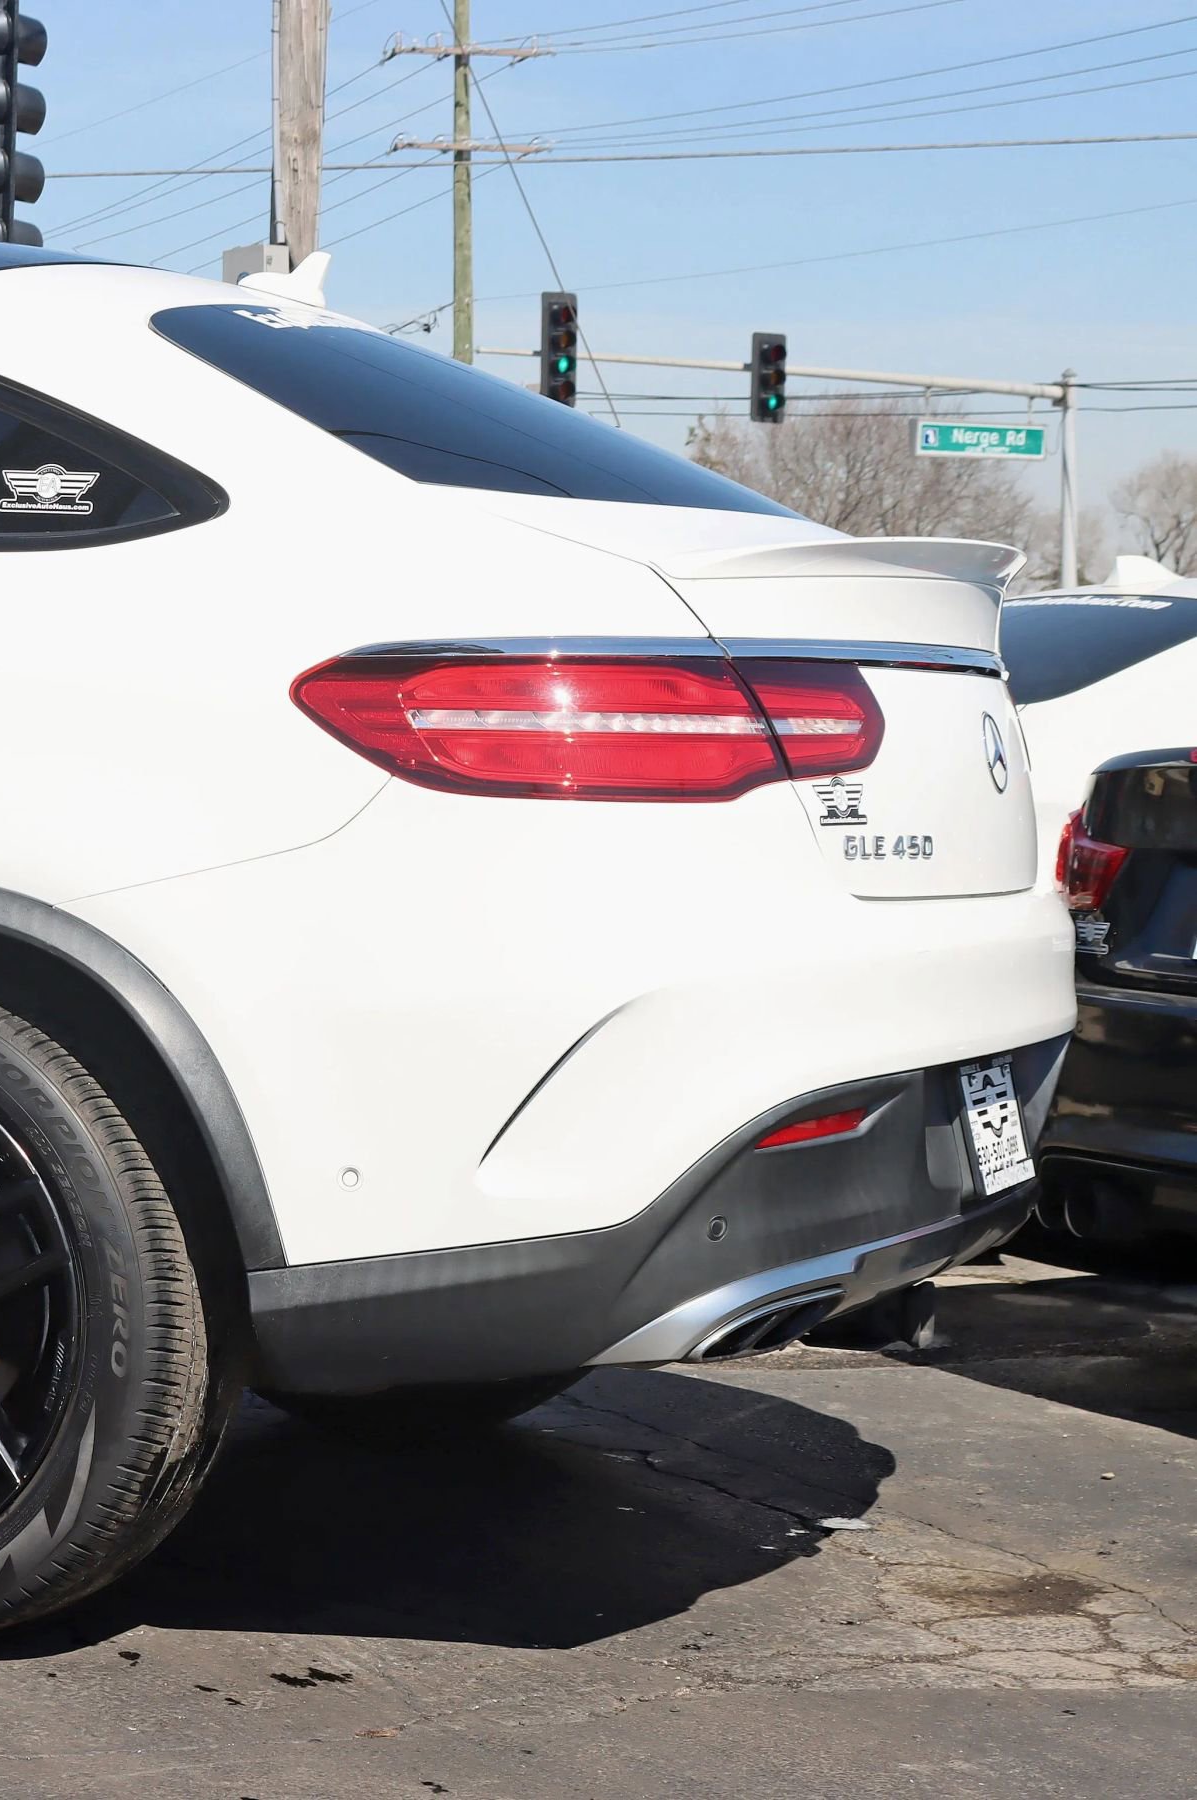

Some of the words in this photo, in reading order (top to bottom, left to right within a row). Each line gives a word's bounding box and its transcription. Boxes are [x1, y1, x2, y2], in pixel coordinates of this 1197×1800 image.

[951, 428, 999, 448] Nerge
[1005, 429, 1027, 446] Rd
[1, 501, 90, 511] ExclusiveAutoHaus.com
[844, 835, 886, 860] GLE
[892, 834, 934, 860] 450
[103, 1236, 131, 1378] ZERO
